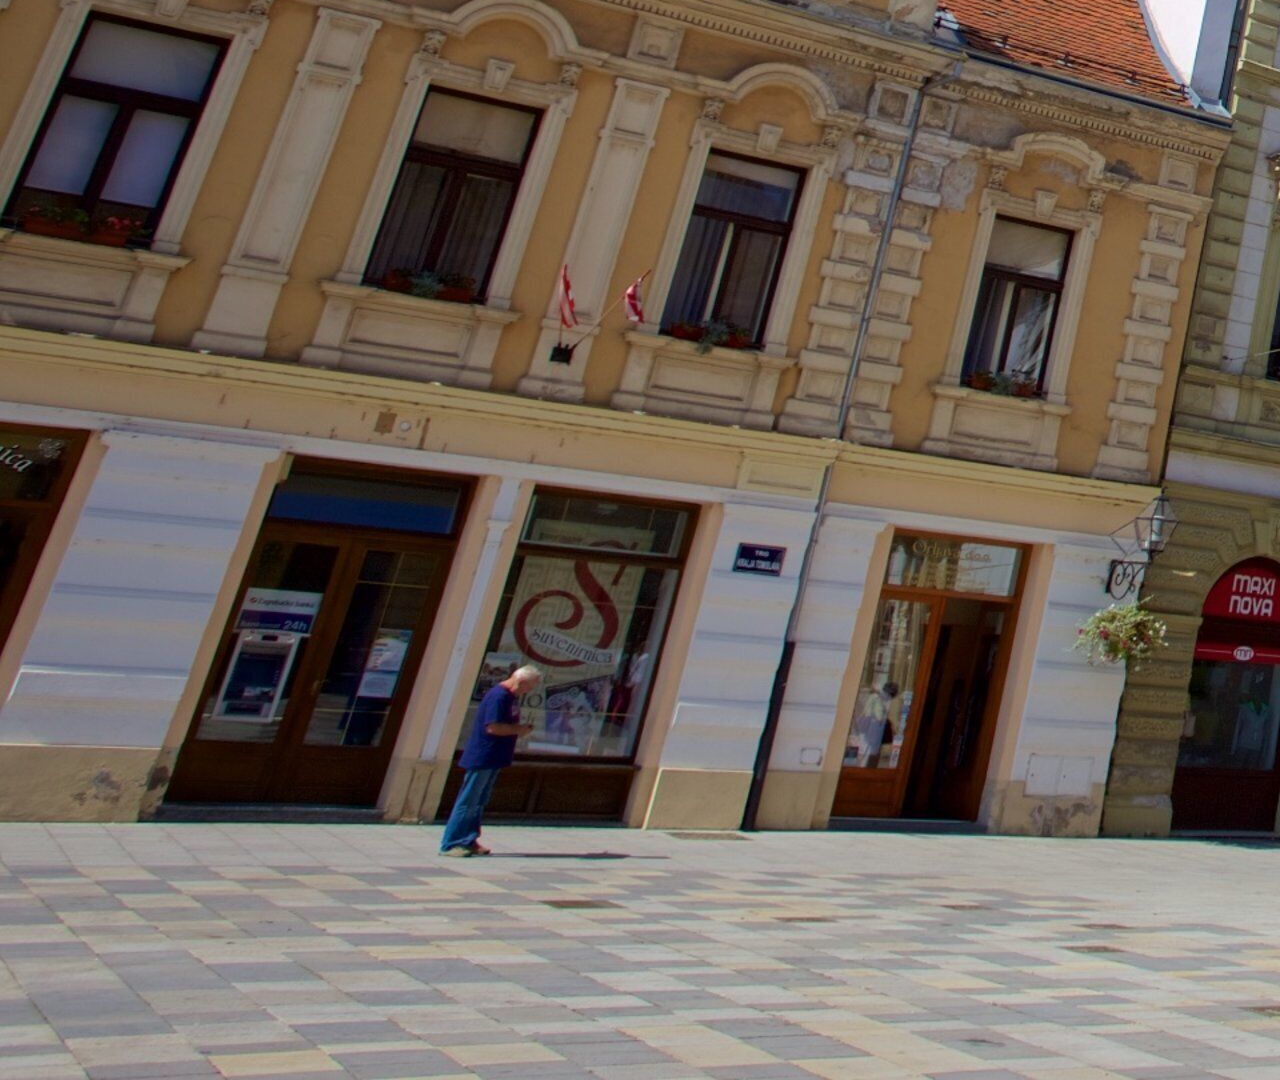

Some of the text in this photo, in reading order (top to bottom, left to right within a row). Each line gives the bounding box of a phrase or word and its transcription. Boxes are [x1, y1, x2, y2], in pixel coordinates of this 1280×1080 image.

[0, 445, 34, 472] ica
[1231, 574, 1276, 596] MAXI
[1228, 595, 1274, 617] NOVA
[282, 620, 308, 632] 24h
